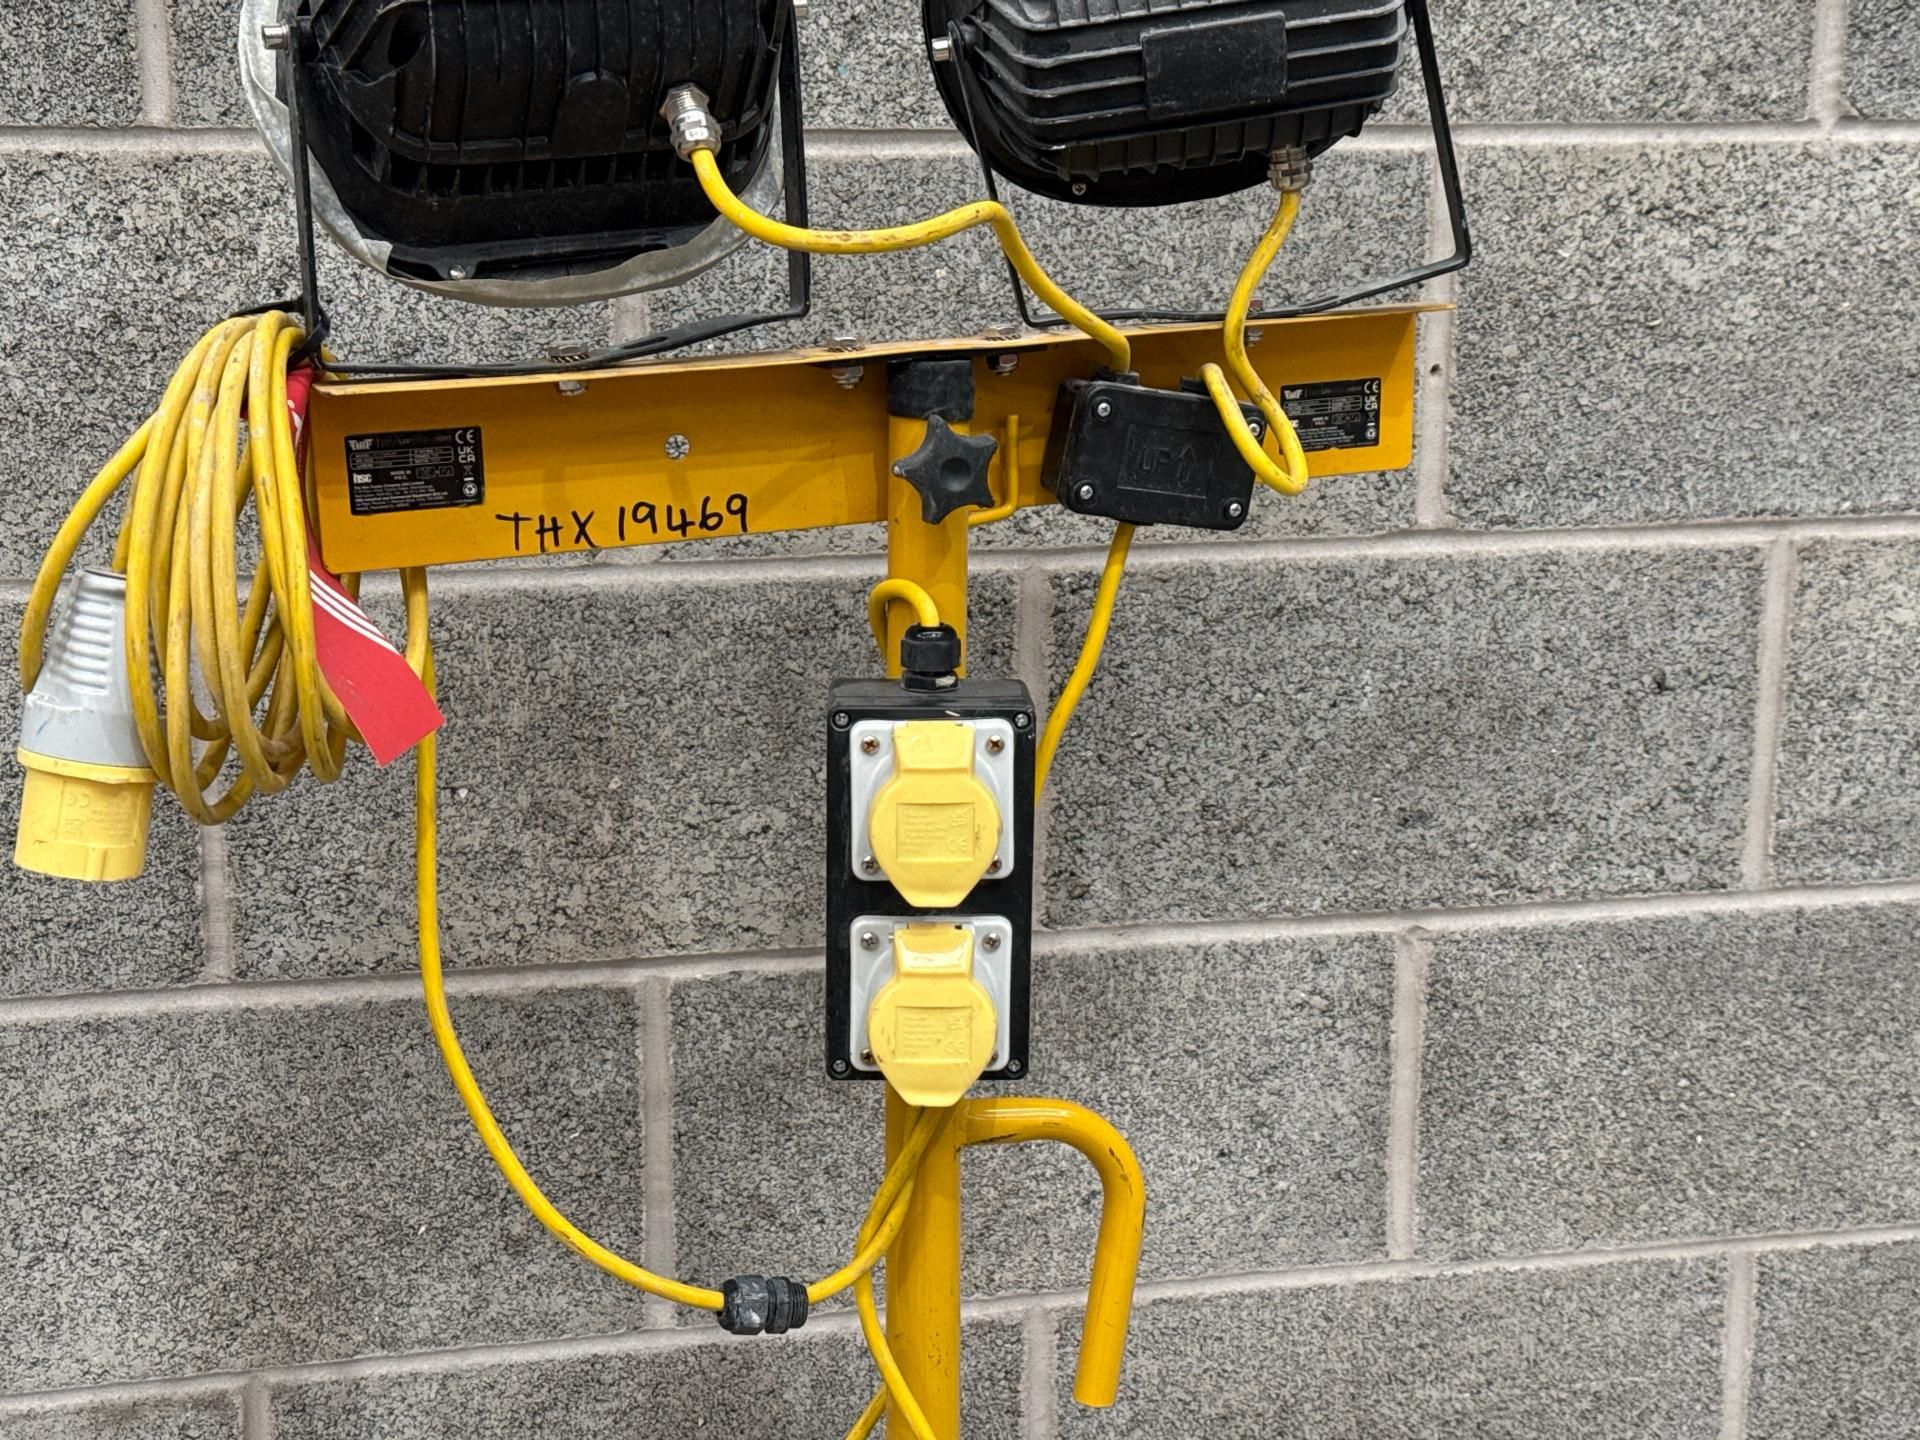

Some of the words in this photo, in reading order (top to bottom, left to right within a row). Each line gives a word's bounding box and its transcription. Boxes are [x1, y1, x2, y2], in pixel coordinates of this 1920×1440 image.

[1364, 381, 1379, 393] CE
[455, 429, 475, 444] CE
[457, 446, 474, 455] UK
[458, 454, 476, 464] CA
[495, 510, 598, 552] THX
[618, 493, 748, 541] 19469
